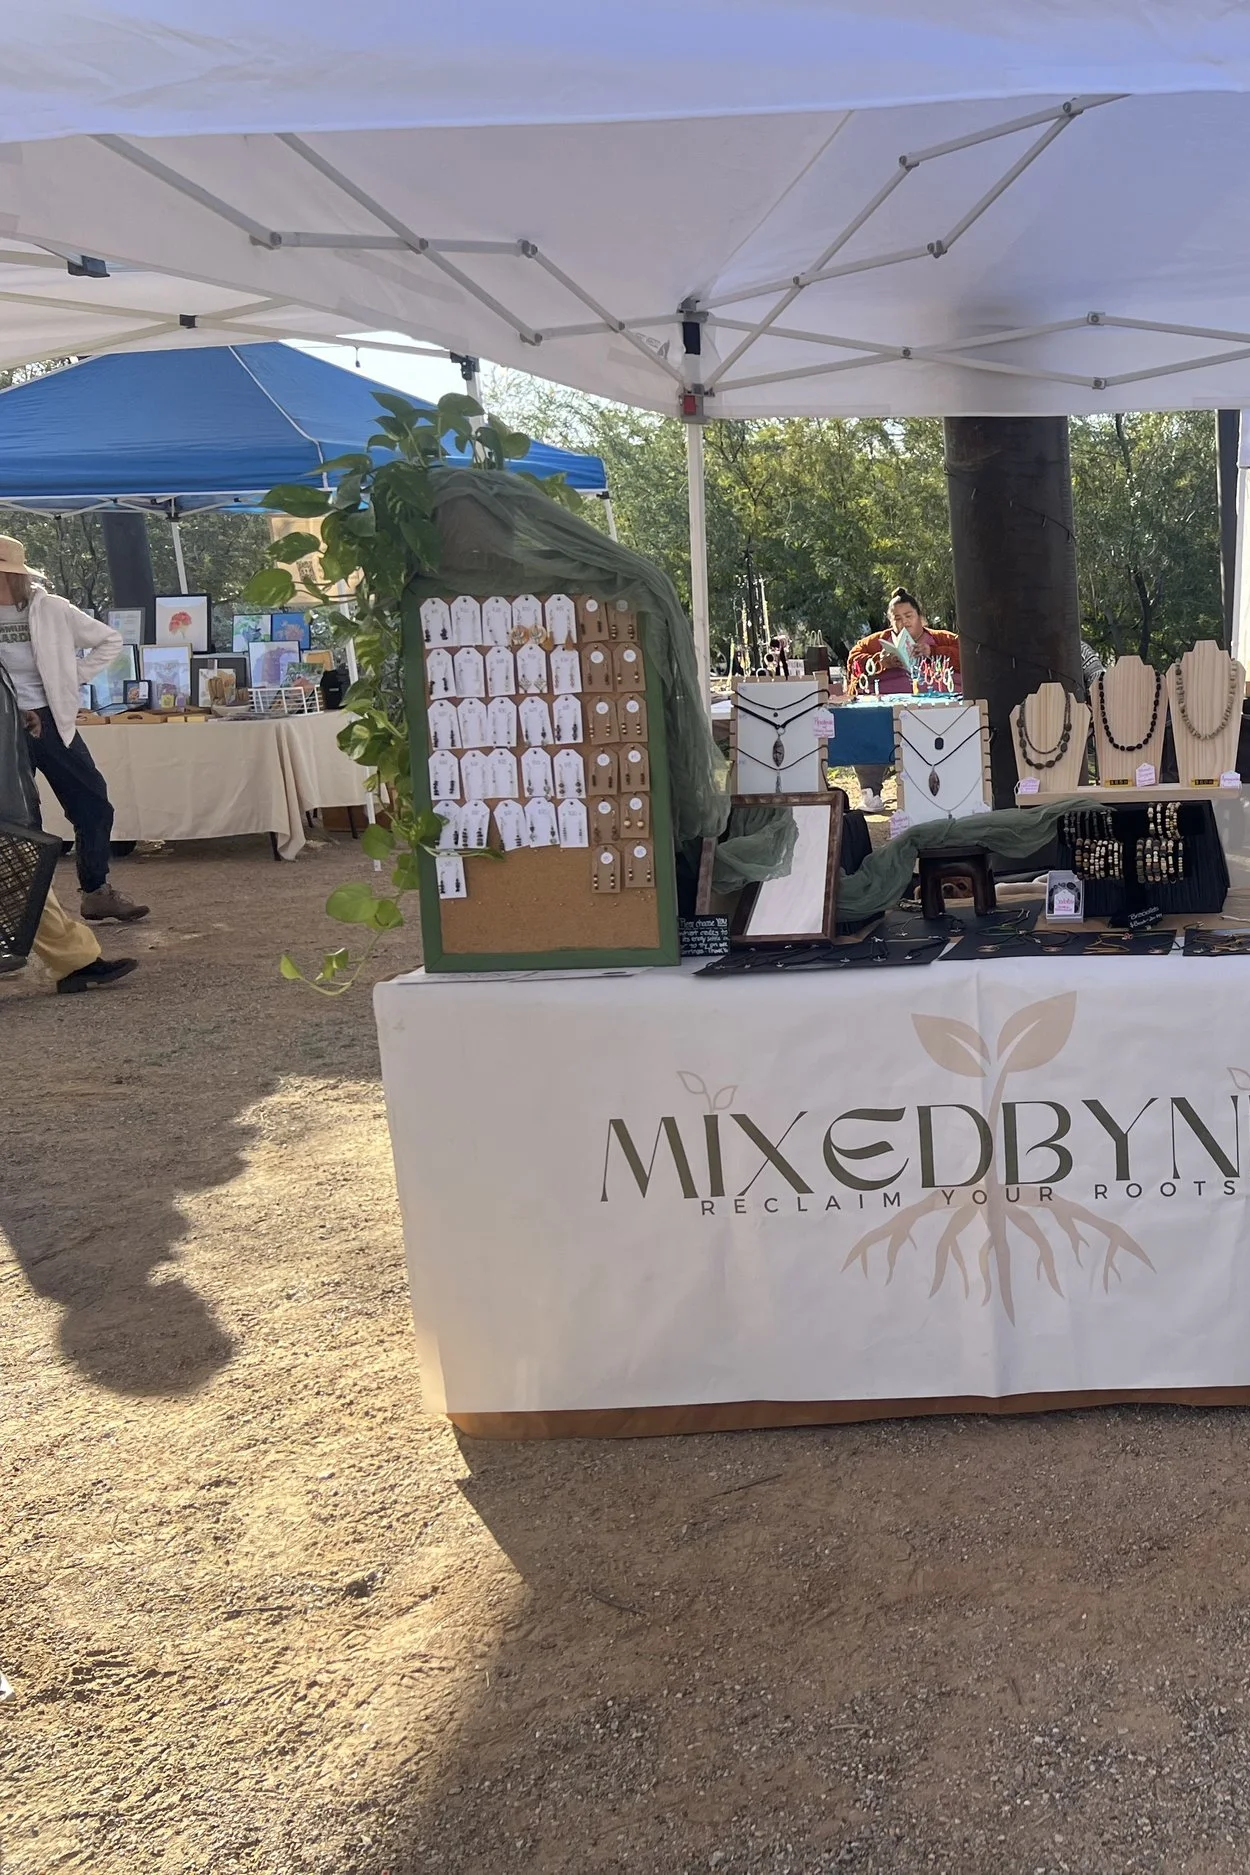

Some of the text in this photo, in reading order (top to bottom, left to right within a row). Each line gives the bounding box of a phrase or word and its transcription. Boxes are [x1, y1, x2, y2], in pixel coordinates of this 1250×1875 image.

[701, 1180, 1236, 1216] RECLAIM YOUR ROOTS
